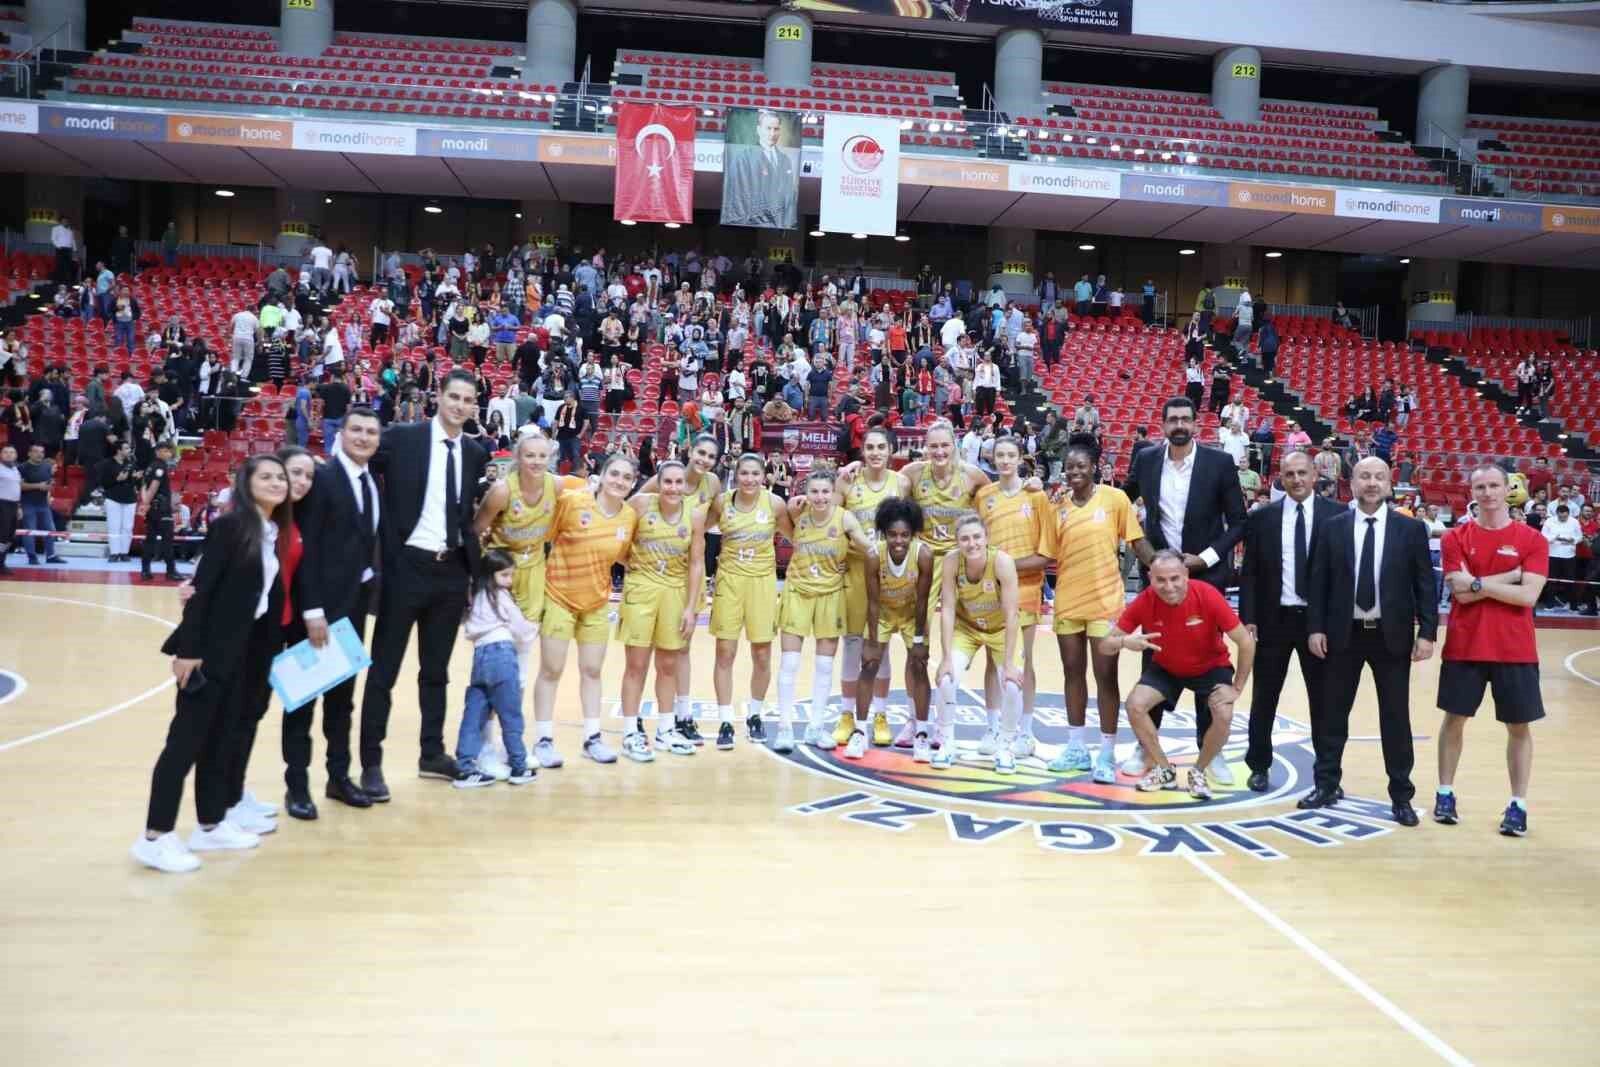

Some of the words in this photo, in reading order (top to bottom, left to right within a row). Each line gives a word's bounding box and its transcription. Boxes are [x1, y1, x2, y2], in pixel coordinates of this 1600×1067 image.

[1059, 15, 1078, 23] SPOR
[778, 26, 800, 38] 214
[1234, 65, 1256, 77] 212
[1032, 175, 1111, 190] mondihome
[1357, 199, 1431, 215] mondihome
